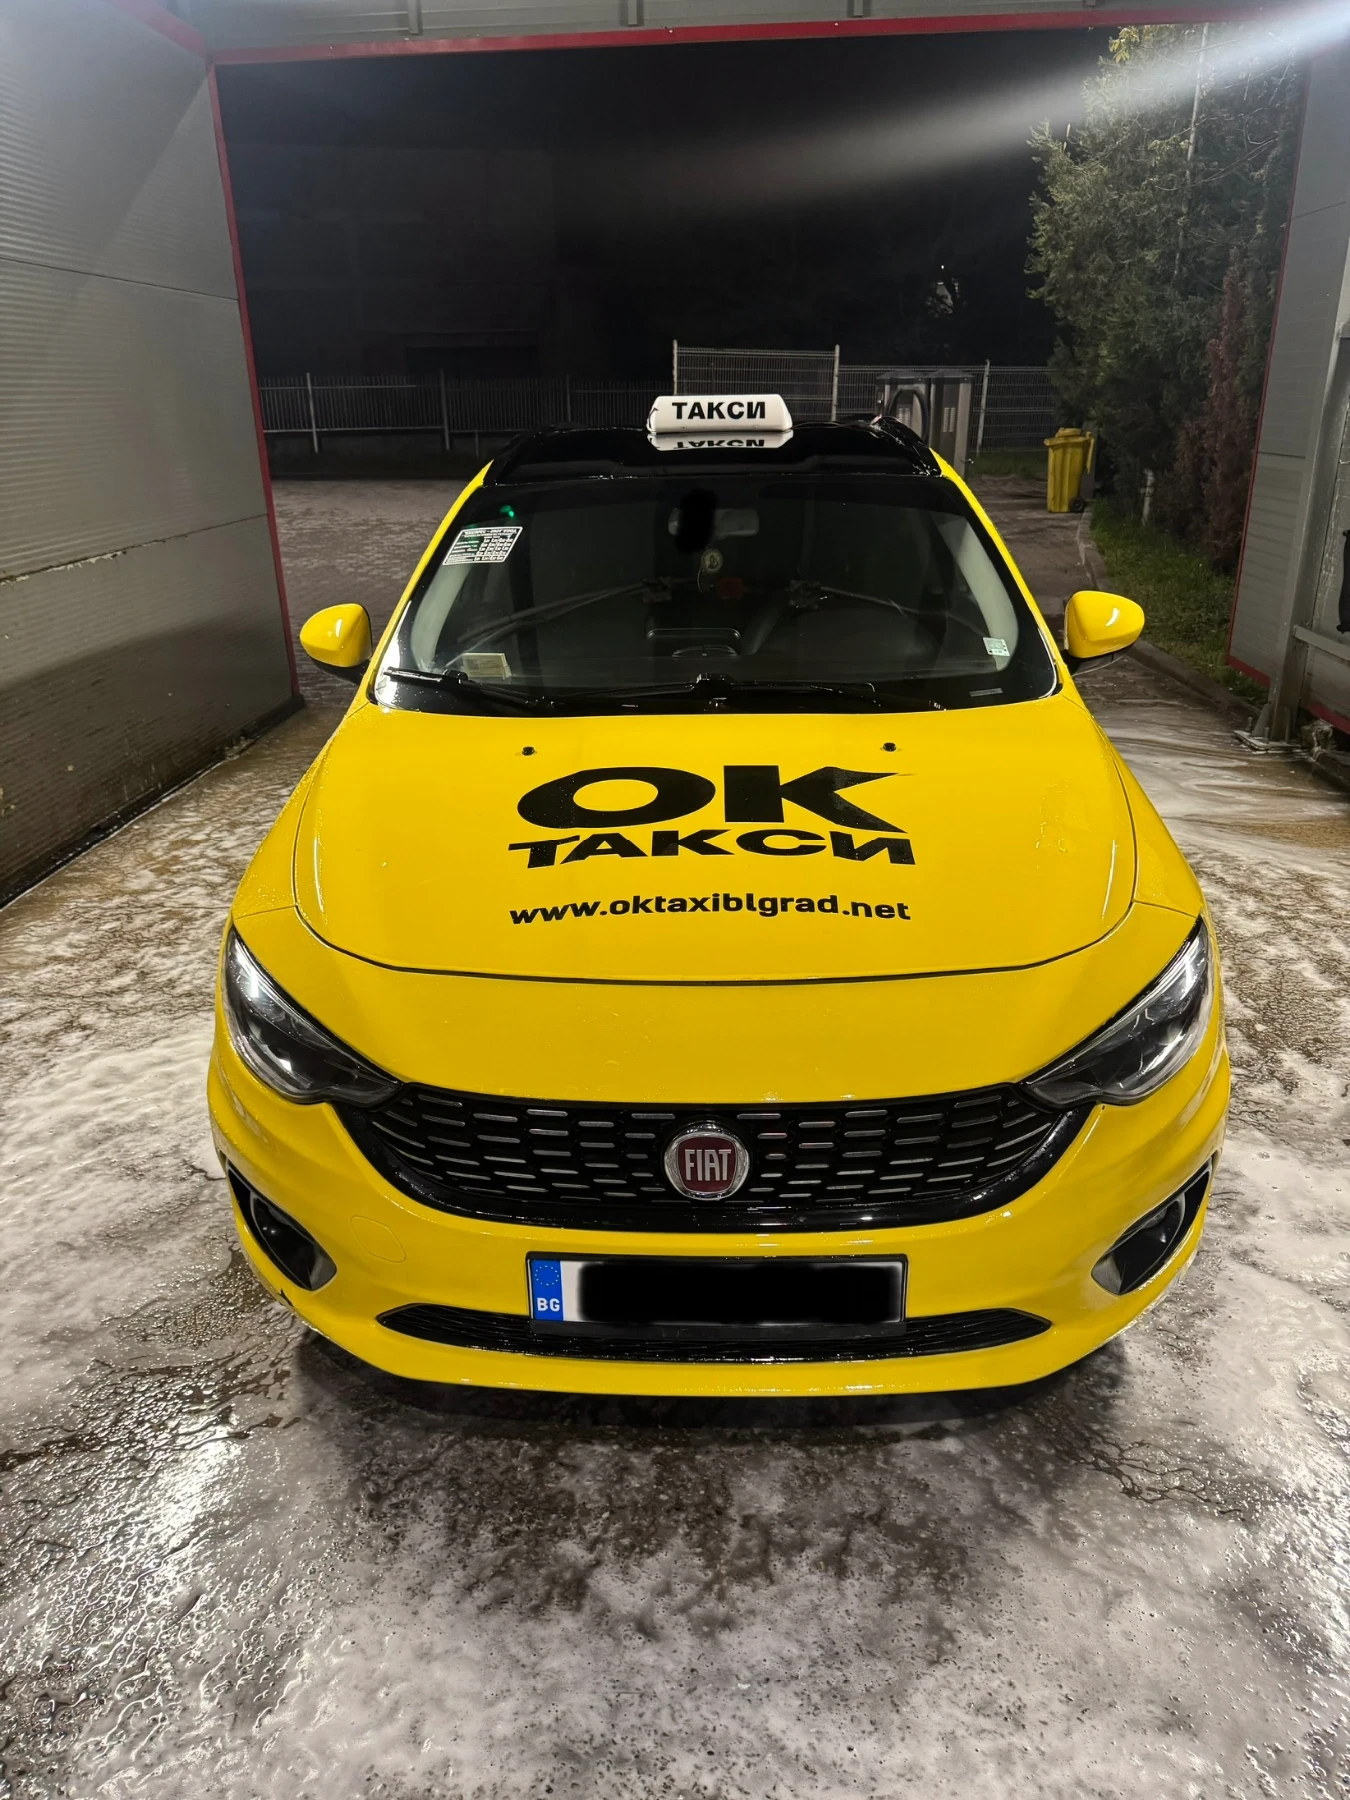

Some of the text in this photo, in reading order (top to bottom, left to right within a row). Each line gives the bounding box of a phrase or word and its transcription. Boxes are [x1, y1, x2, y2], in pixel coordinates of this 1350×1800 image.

[672, 402, 766, 420] ТАКСИ
[508, 829, 916, 868] ТАКСИ
[509, 893, 911, 924] www.oktaxiblgrad.net
[684, 1149, 732, 1181] FIAT
[536, 1297, 560, 1312] BG
